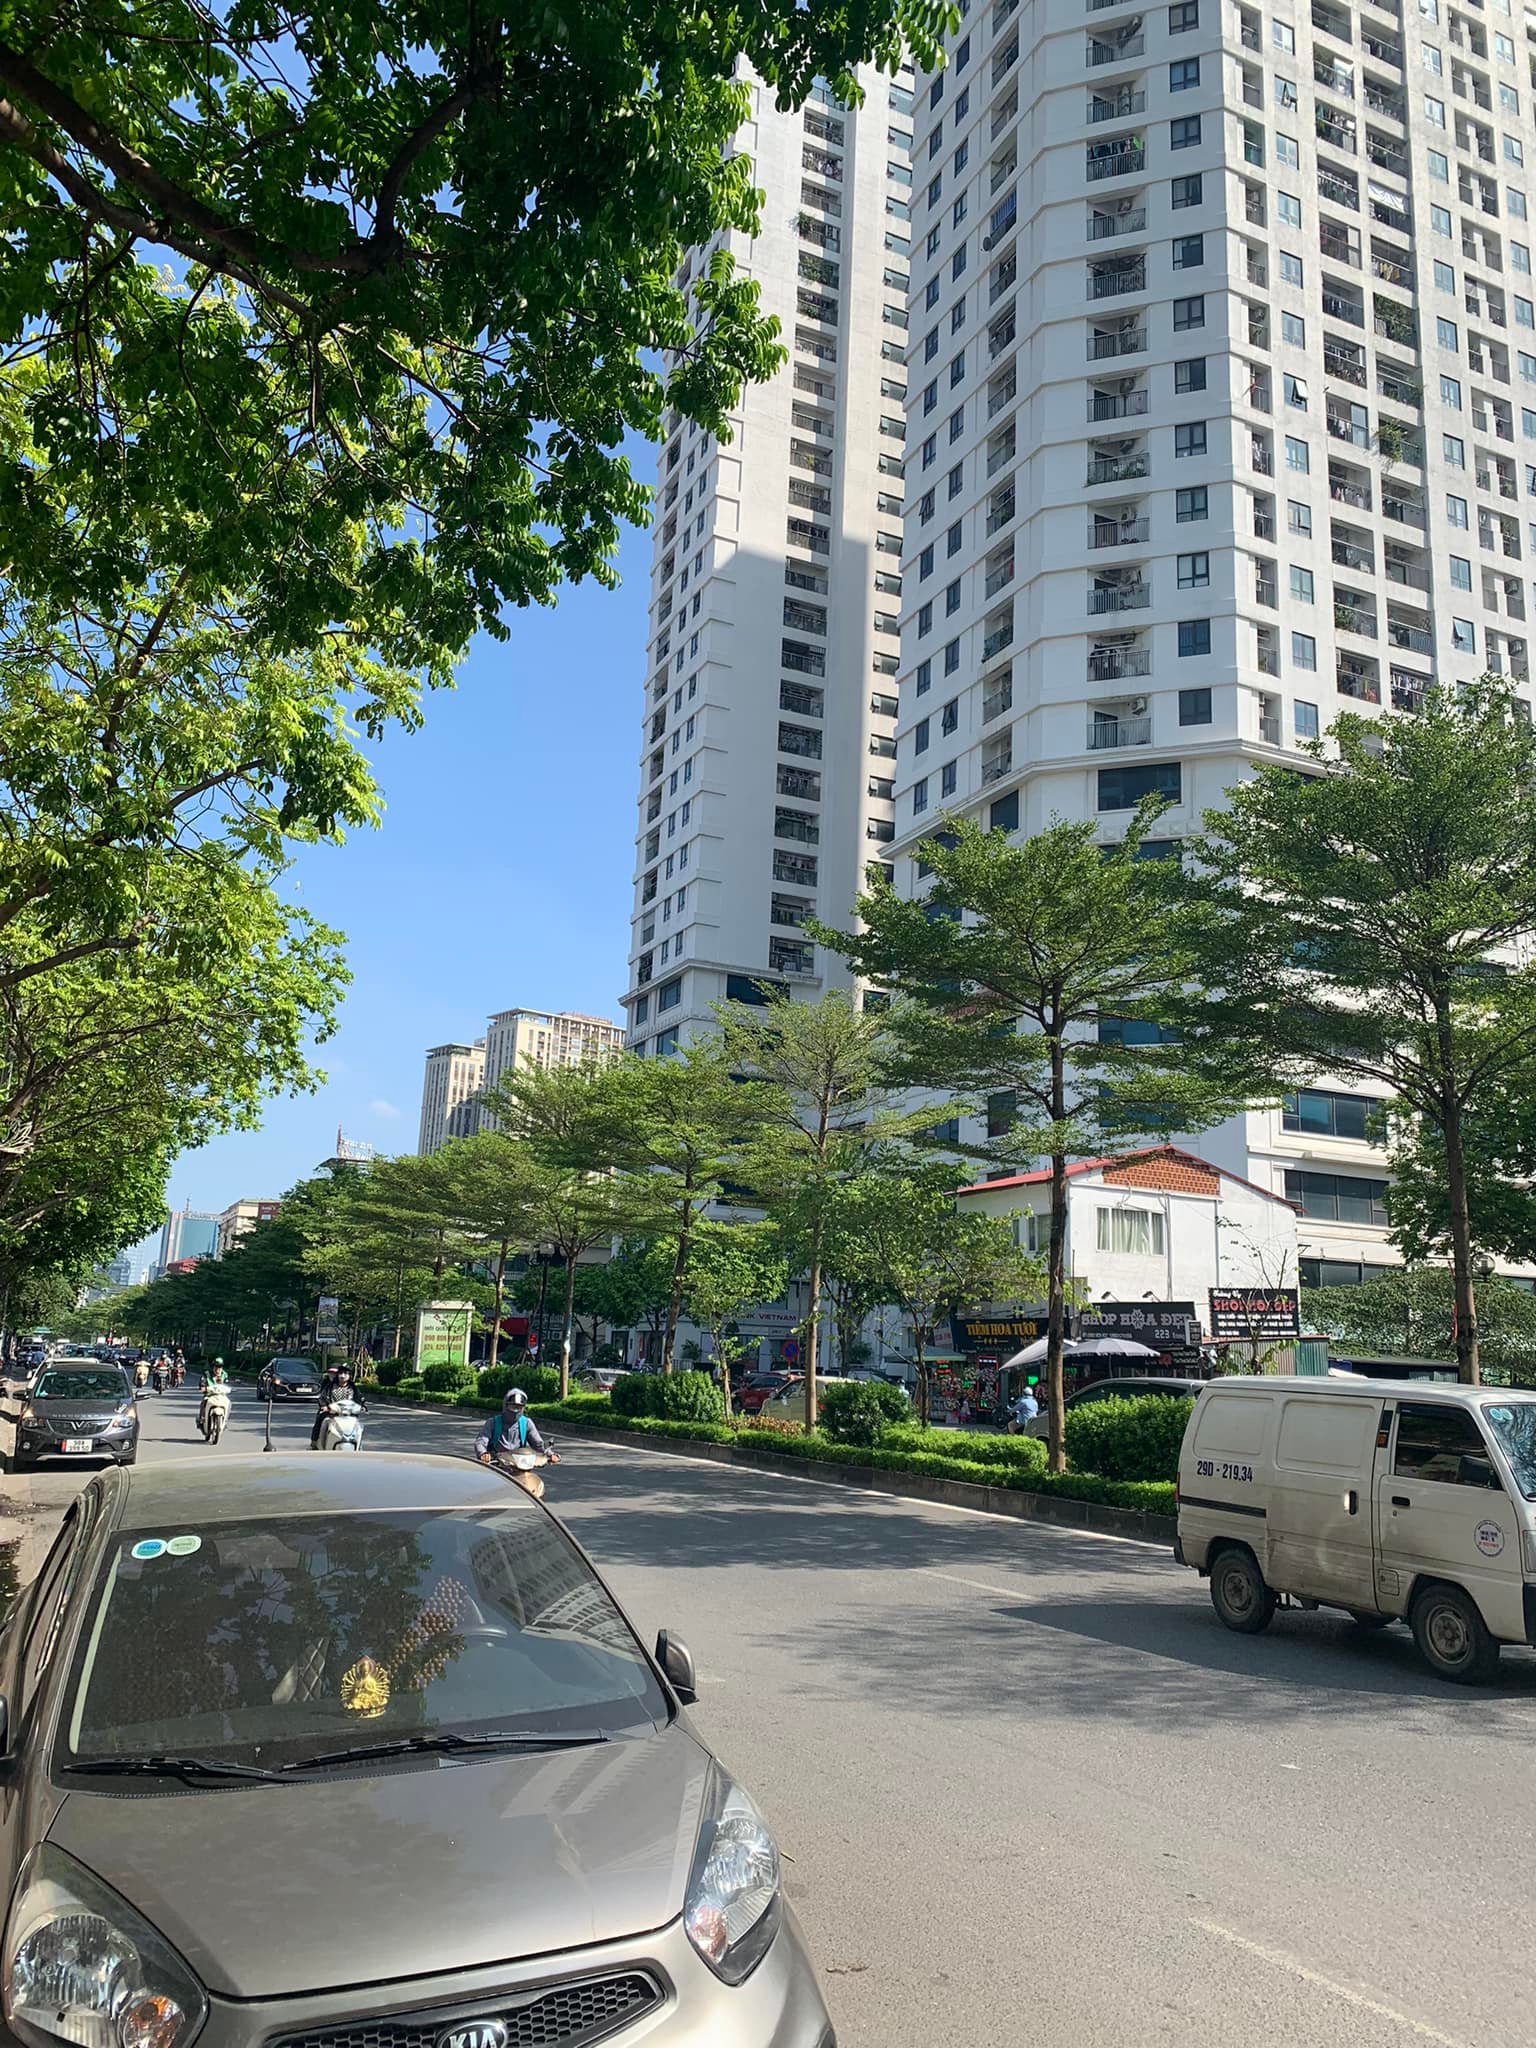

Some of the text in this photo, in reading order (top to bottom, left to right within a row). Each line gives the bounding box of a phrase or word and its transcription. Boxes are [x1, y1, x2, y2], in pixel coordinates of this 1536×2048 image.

[760, 1312, 797, 1321] VIETNAM
[1081, 1313, 1117, 1326] SHOP
[1160, 1313, 1193, 1329] ĐẸP
[991, 1322, 1012, 1336] HOA
[1154, 1329, 1170, 1339] 223
[1197, 1460, 1214, 1477] 29D
[1222, 1463, 1253, 1482] 219.34
[449, 2028, 498, 2048] KIA
